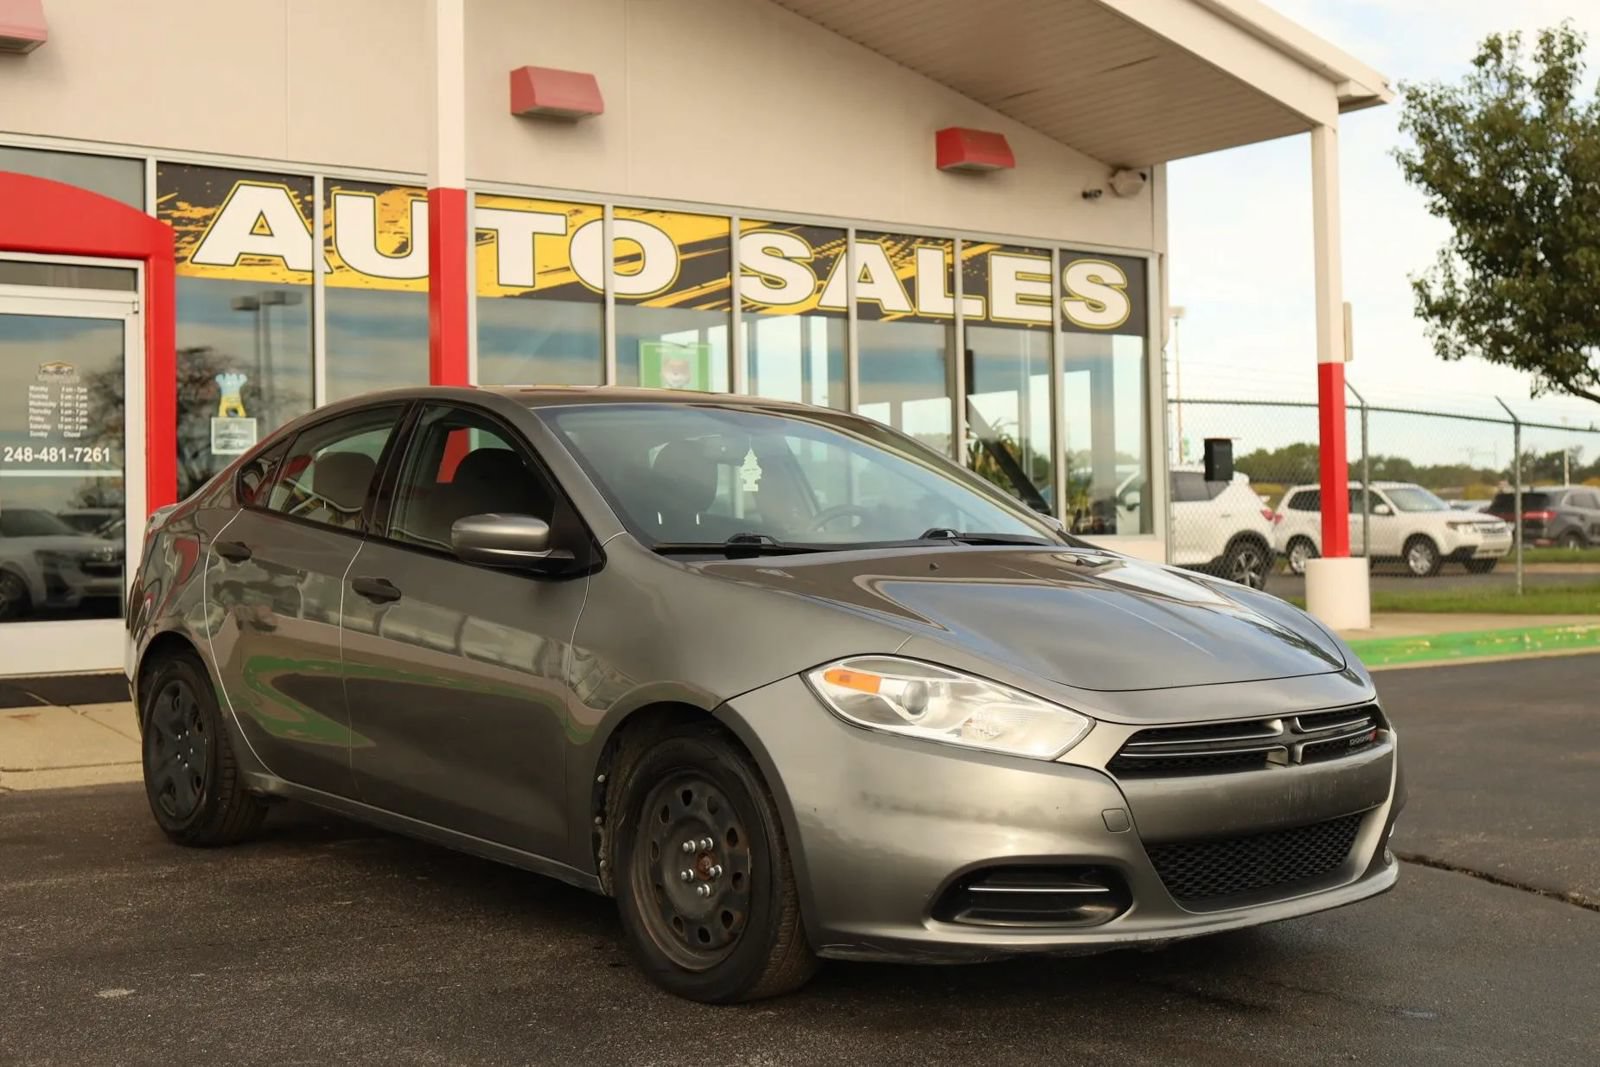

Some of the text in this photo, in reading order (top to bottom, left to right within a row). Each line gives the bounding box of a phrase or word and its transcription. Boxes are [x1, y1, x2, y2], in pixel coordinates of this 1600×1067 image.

[190, 181, 1130, 329] AUTO SALES
[4, 446, 110, 462] 248-481-7261
